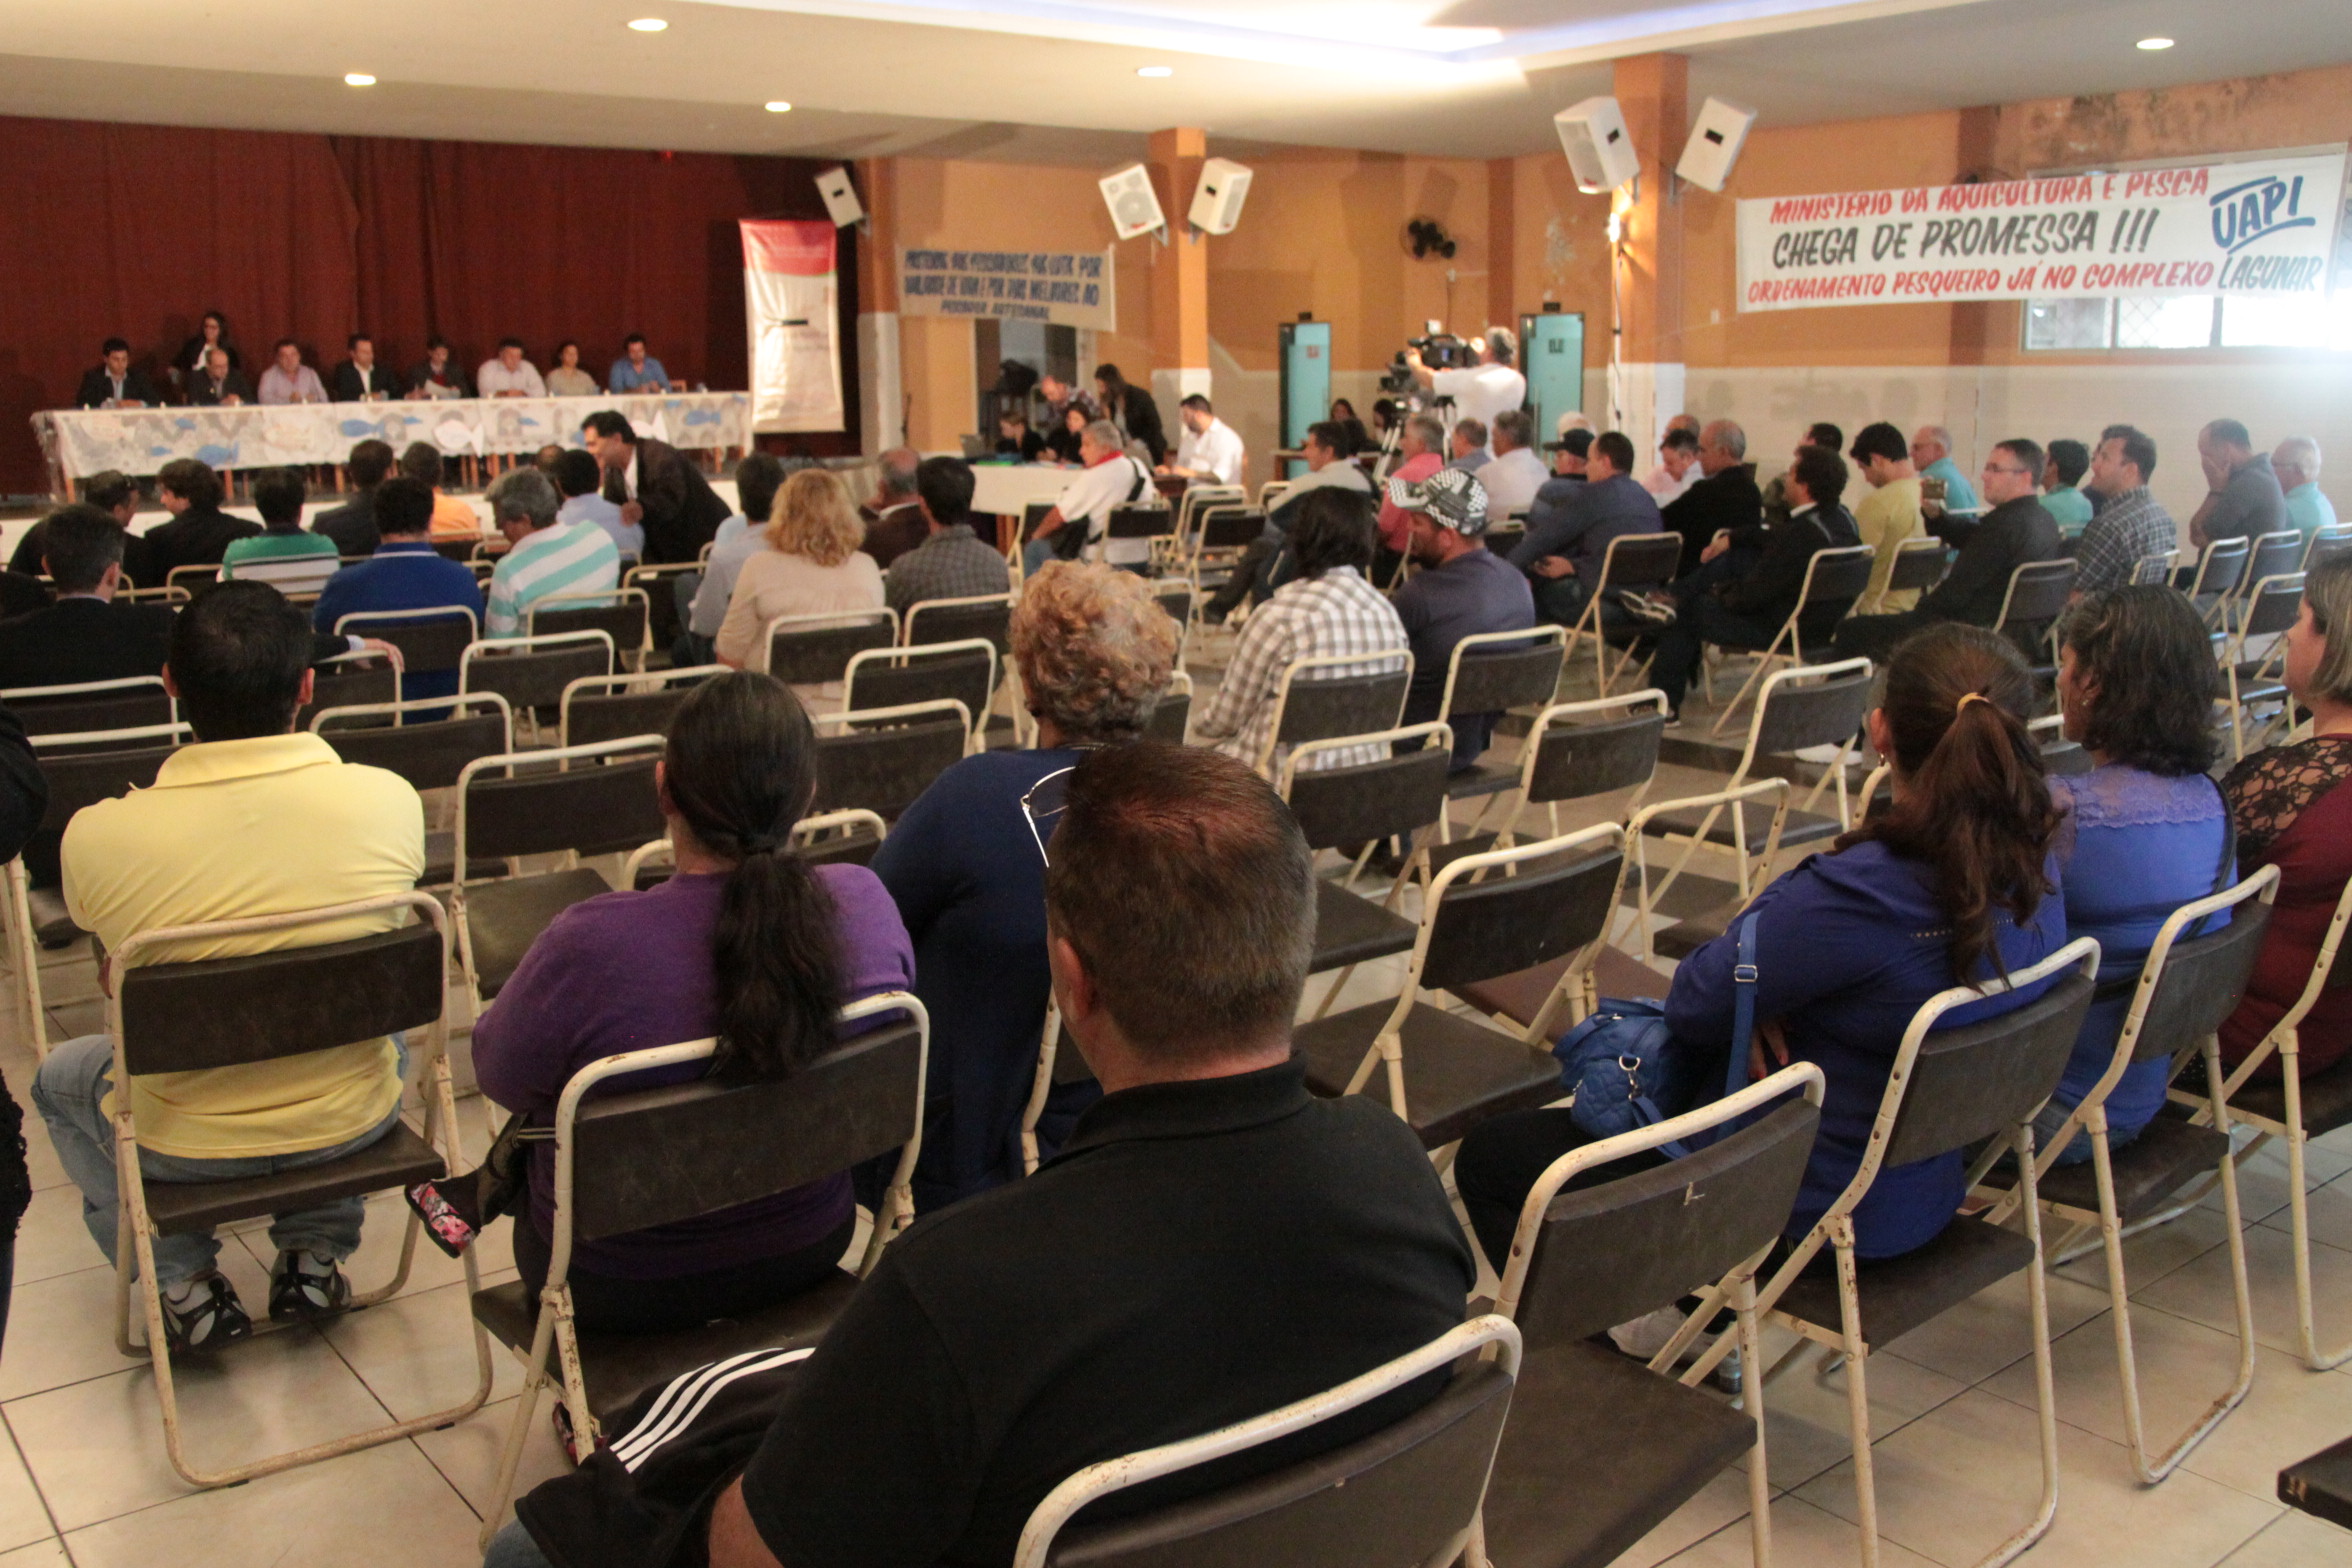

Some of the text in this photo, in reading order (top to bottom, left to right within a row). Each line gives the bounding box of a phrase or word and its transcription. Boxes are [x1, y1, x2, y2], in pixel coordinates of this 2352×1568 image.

[1901, 188, 1928, 213] DA
[1937, 176, 2093, 214] AQUICULTURA
[2102, 174, 2118, 200] E
[2125, 168, 2210, 199] PESCA
[2211, 175, 2304, 249] UAPI
[1772, 208, 2161, 269] CHEGA DE PROMESSA !!!
[1747, 272, 1887, 304] ORDENAMENTO
[1891, 268, 2001, 298] PESQUEIRO
[2041, 263, 2078, 290] NO
[2081, 260, 2216, 291] COMPLEXO
[2217, 254, 2324, 292] LAGUNAR
